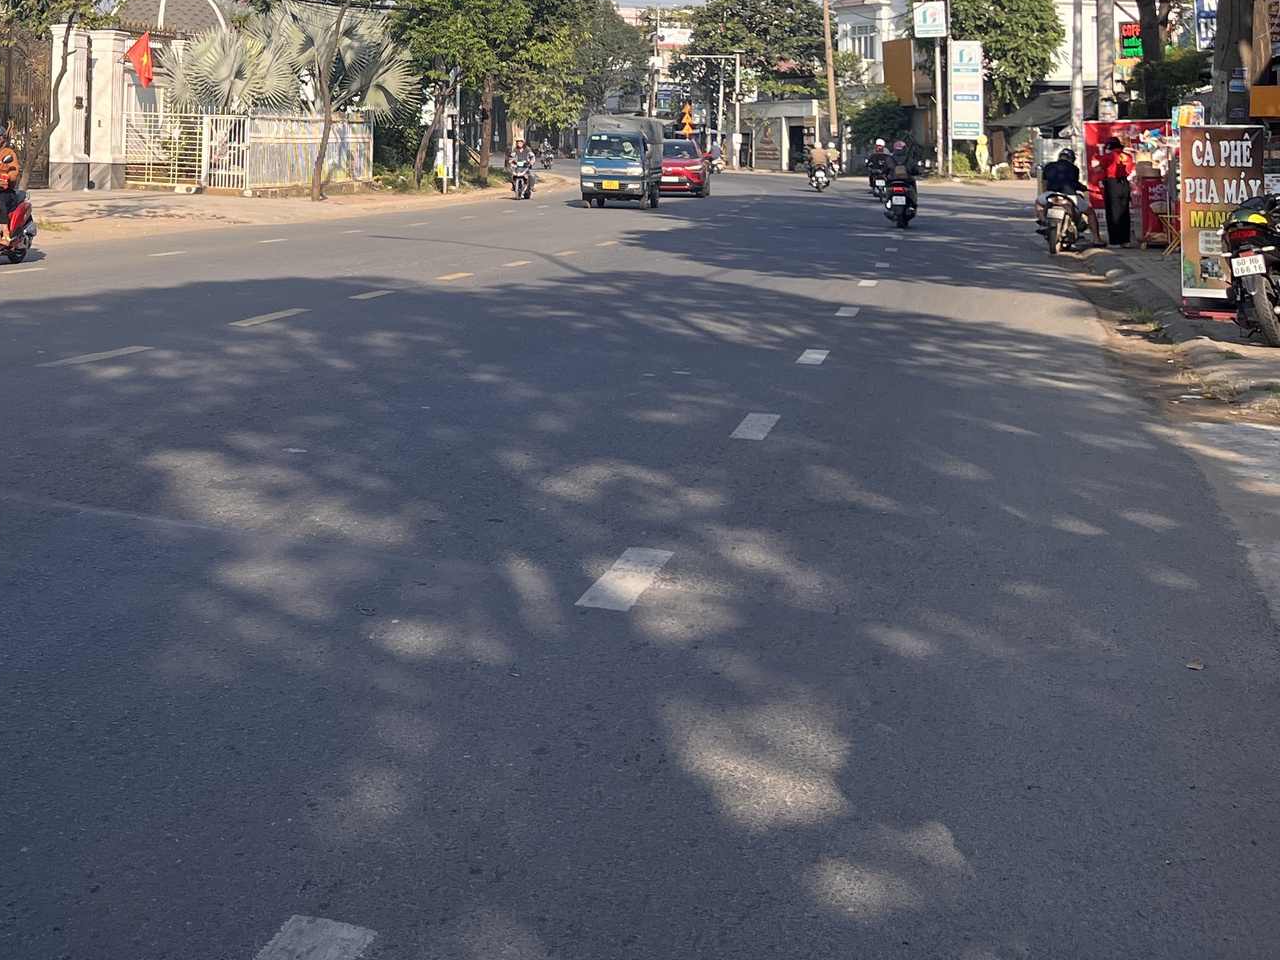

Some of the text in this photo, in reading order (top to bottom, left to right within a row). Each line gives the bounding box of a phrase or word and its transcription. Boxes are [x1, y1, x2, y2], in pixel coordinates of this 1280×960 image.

[1122, 24, 1141, 37] COFF
[1191, 132, 1253, 168] CÀ PHÊ
[1184, 178, 1220, 204] PHA
[1223, 171, 1262, 205] MÁY
[1234, 264, 1264, 275] 066.16
